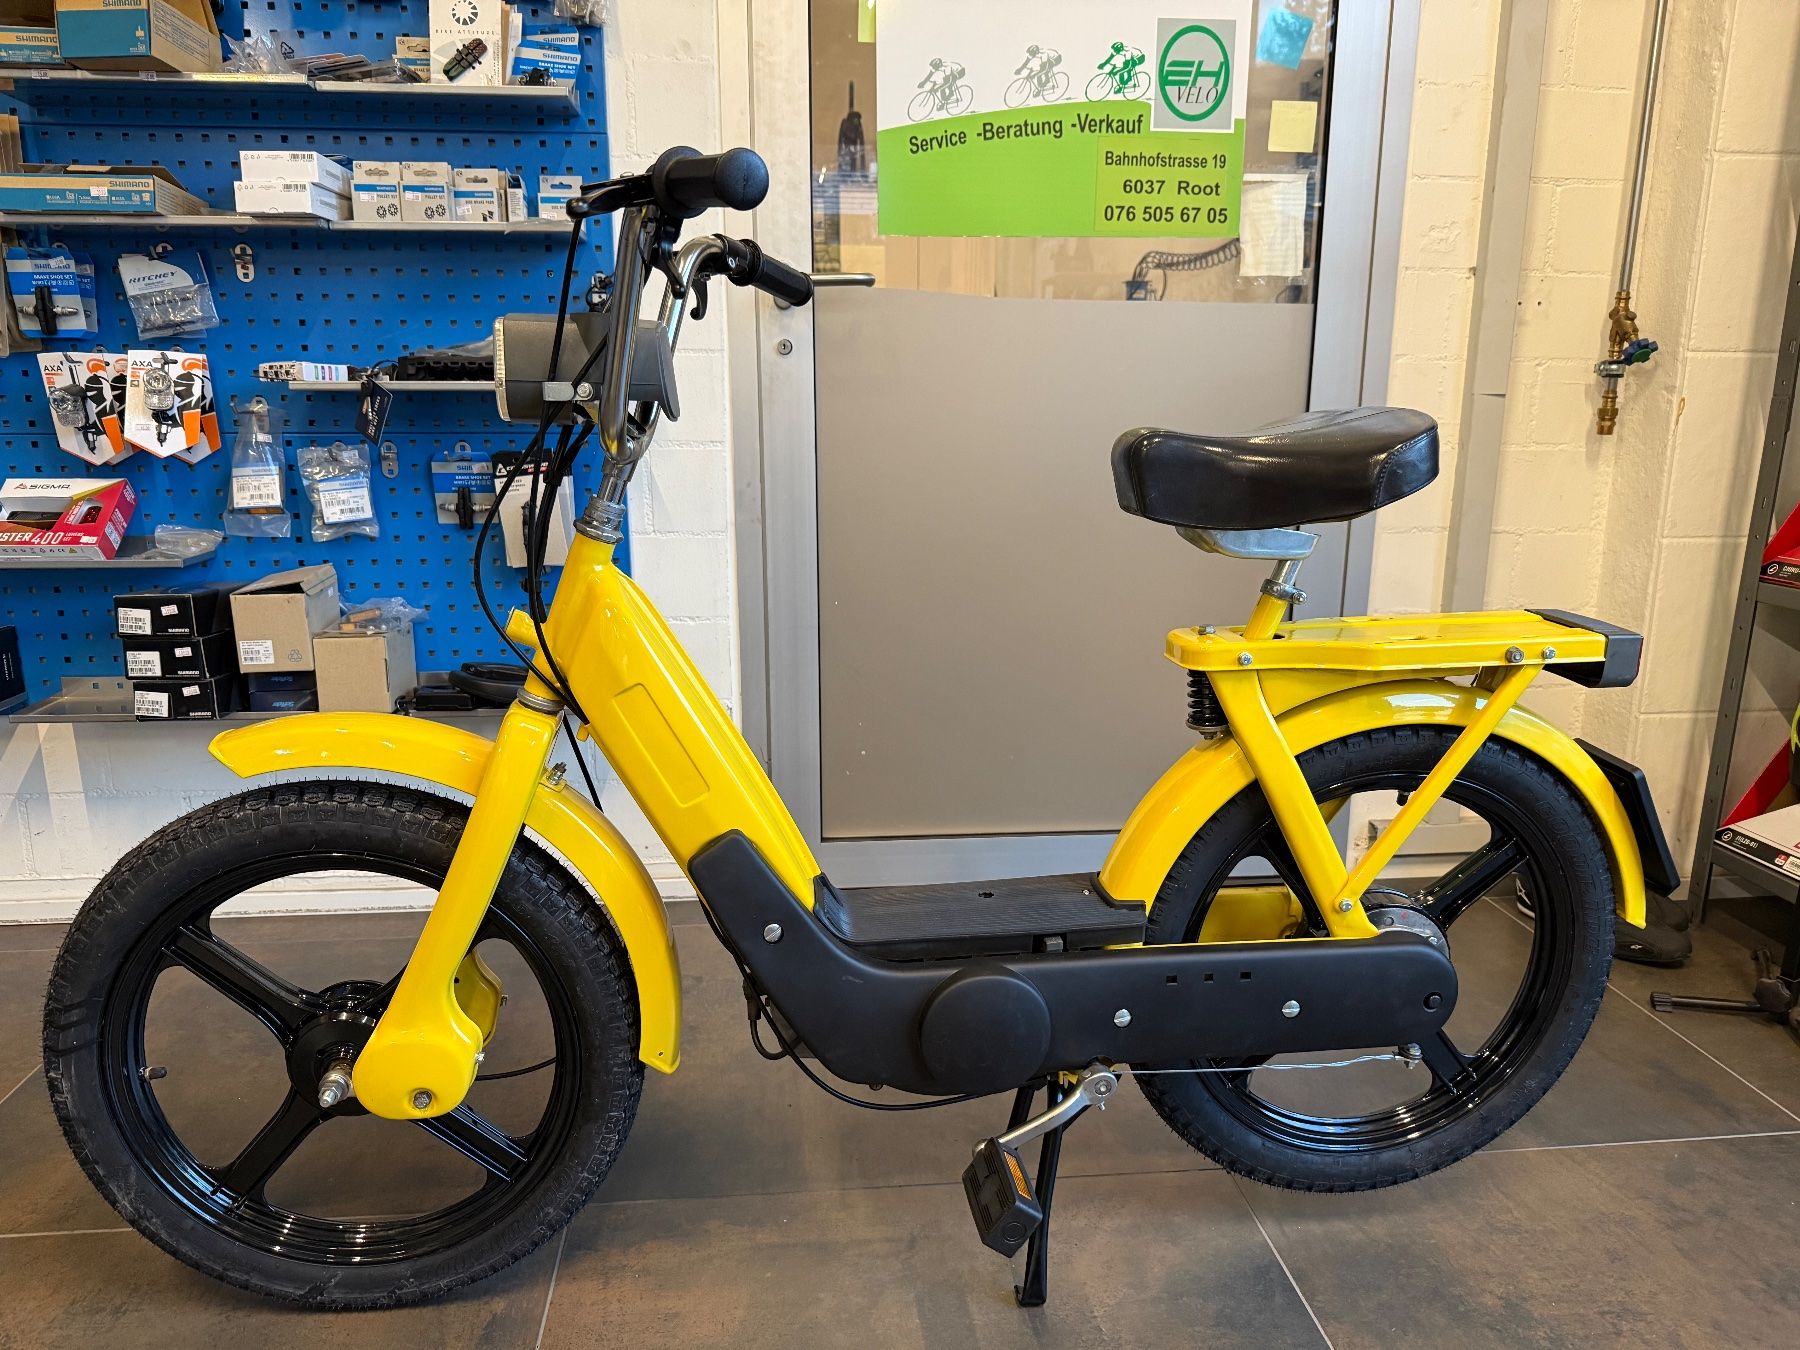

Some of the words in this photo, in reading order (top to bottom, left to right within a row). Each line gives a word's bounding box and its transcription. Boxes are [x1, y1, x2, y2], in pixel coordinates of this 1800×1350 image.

[16, 35, 57, 43] SHIMANO
[542, 52, 579, 62] SHIMANO
[1177, 86, 1219, 104] VELO
[909, 129, 967, 154] Service
[977, 119, 1064, 141] -Beratung
[1071, 113, 1144, 134] -Verkauf
[1105, 151, 1208, 168] Bahnhofstrasse
[1212, 154, 1226, 169] 19
[109, 180, 150, 188] SHIMANO
[1123, 179, 1166, 195] 6037
[1177, 181, 1221, 196] Root
[1104, 205, 1136, 222] 076
[1142, 206, 1174, 222] 505
[1180, 207, 1201, 223] 67
[1207, 208, 1228, 224] 05
[128, 270, 177, 283] RITCHEY
[43, 365, 62, 373] AXA
[31, 532, 65, 545] 400
